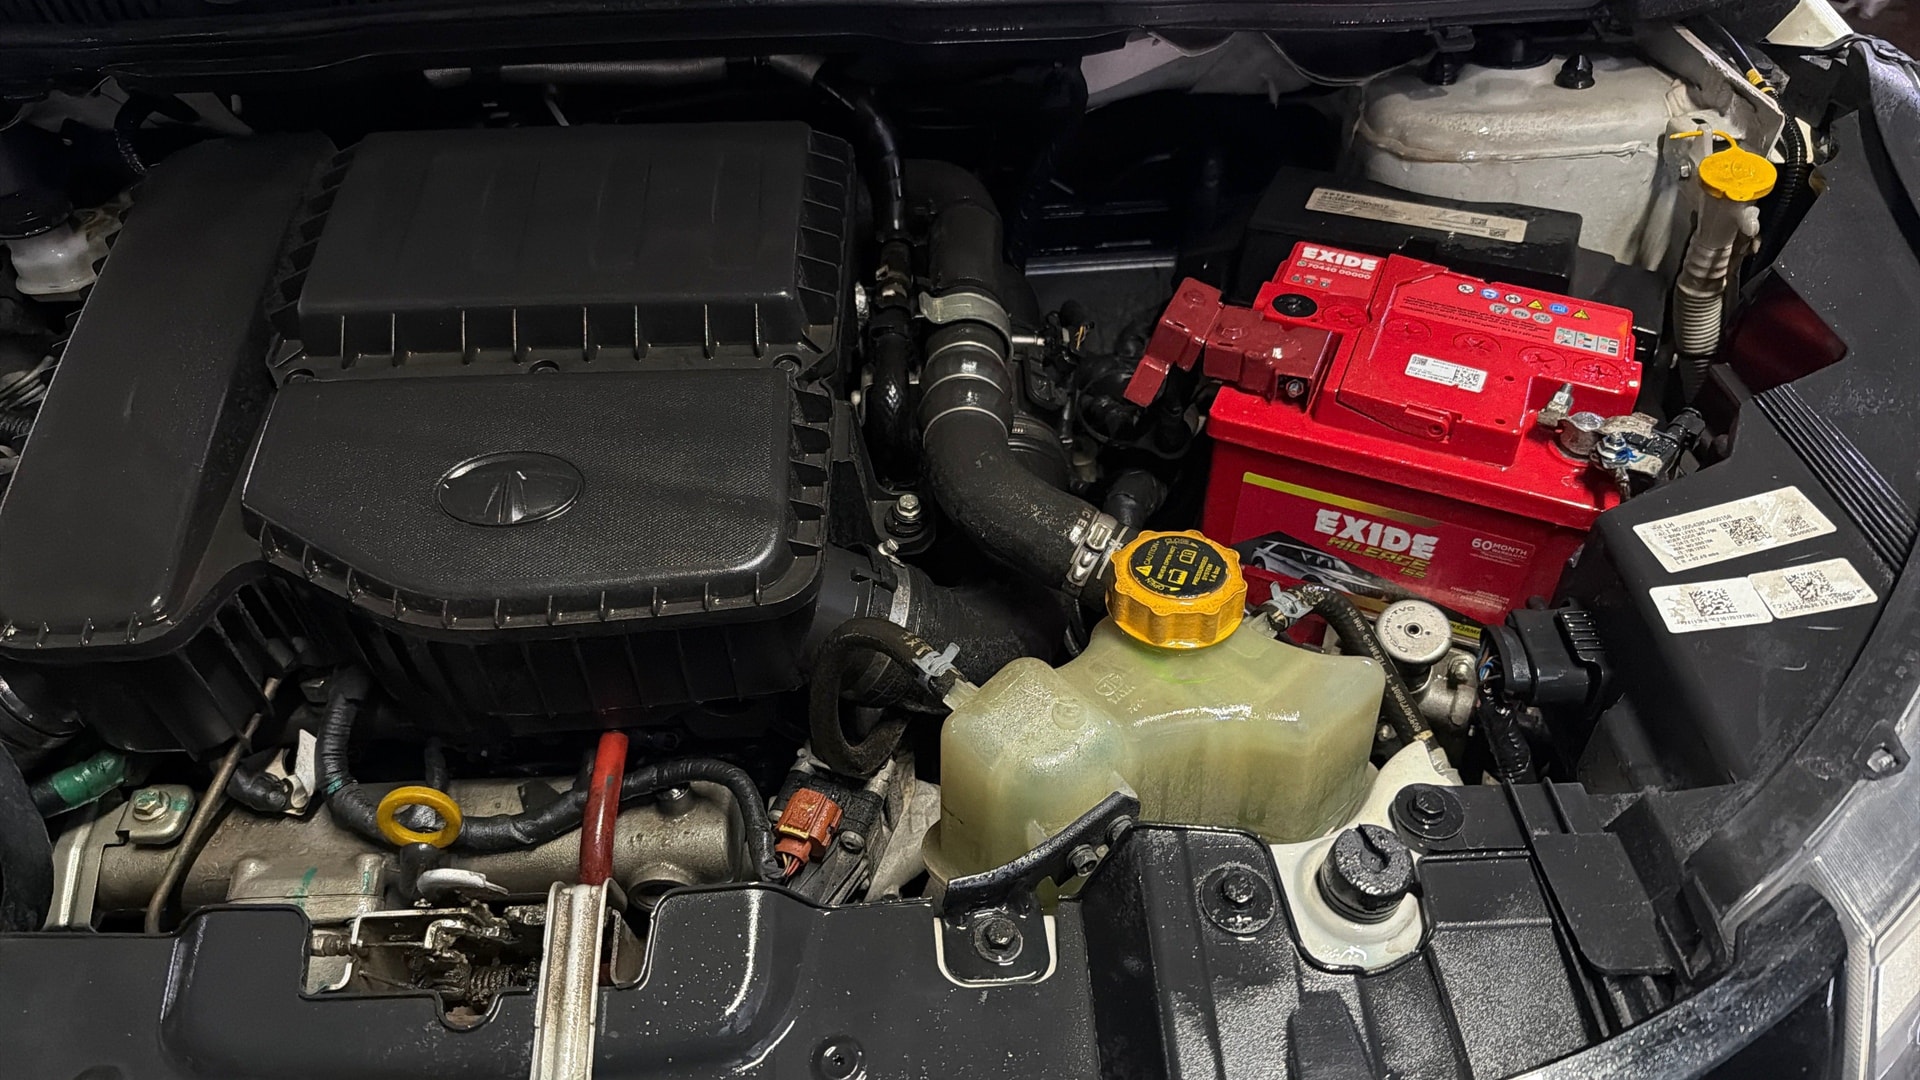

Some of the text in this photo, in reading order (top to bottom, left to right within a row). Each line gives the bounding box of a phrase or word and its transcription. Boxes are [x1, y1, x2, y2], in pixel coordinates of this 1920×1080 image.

[1302, 246, 1377, 271] EXIDE
[1314, 508, 1439, 560] EXIDE
[1471, 538, 1527, 556] 60 MONTH
[1327, 536, 1431, 571] MILEAGE
